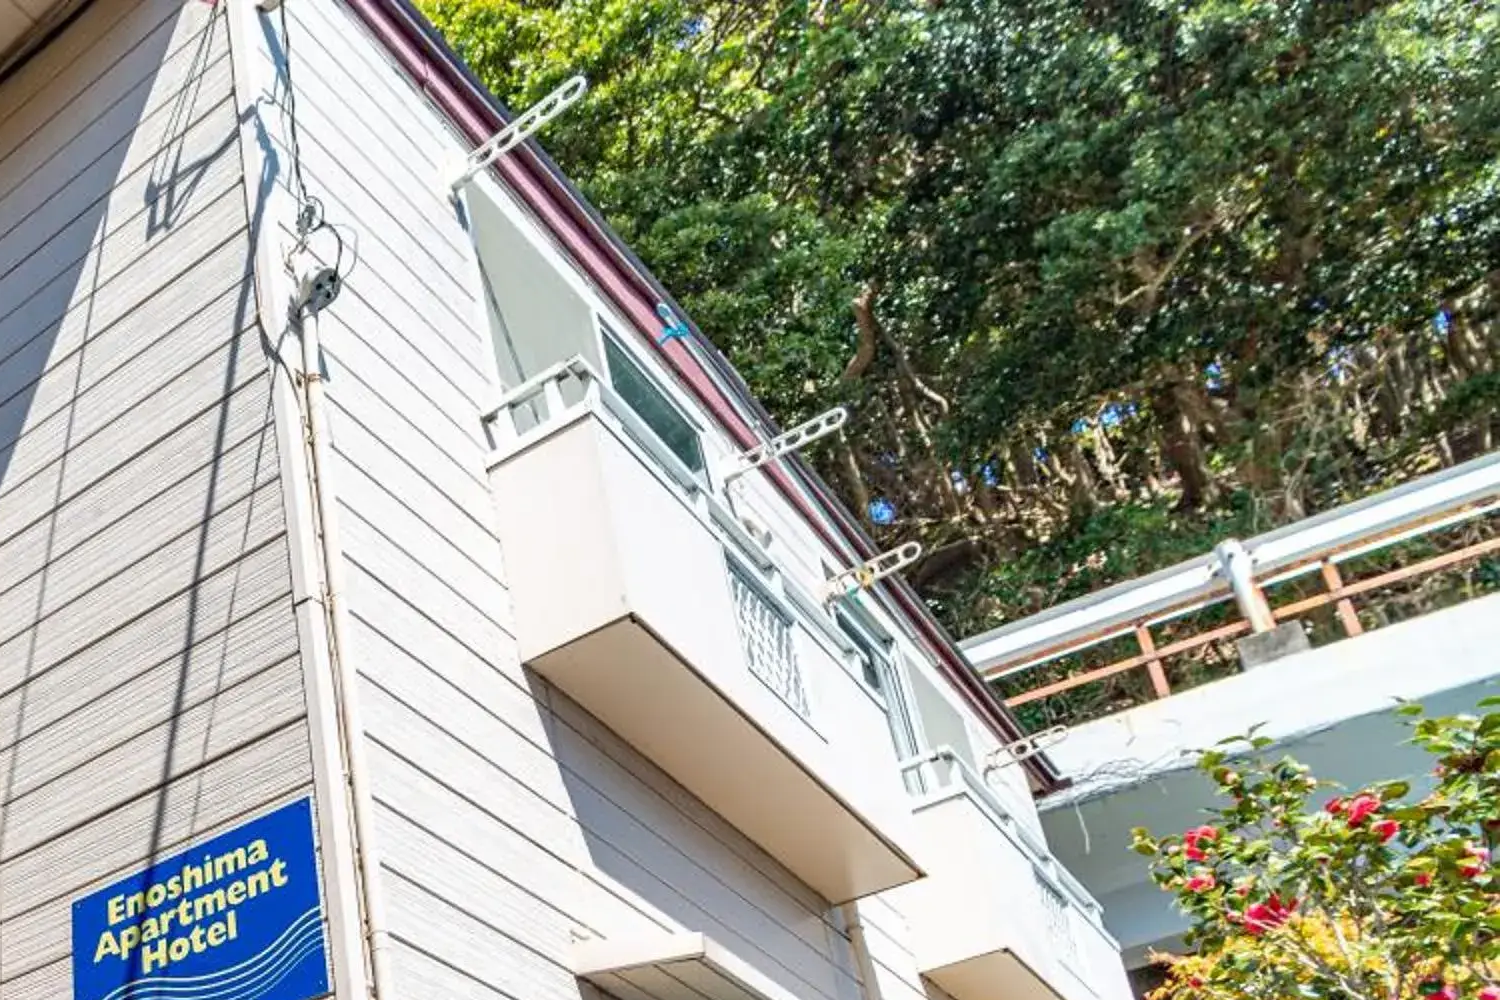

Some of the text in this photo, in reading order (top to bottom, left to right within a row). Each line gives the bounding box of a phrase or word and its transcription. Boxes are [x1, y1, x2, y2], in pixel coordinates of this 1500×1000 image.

[94, 858, 288, 964] Apartment
[107, 838, 269, 927] Enoshima
[141, 910, 237, 975] Hotel
